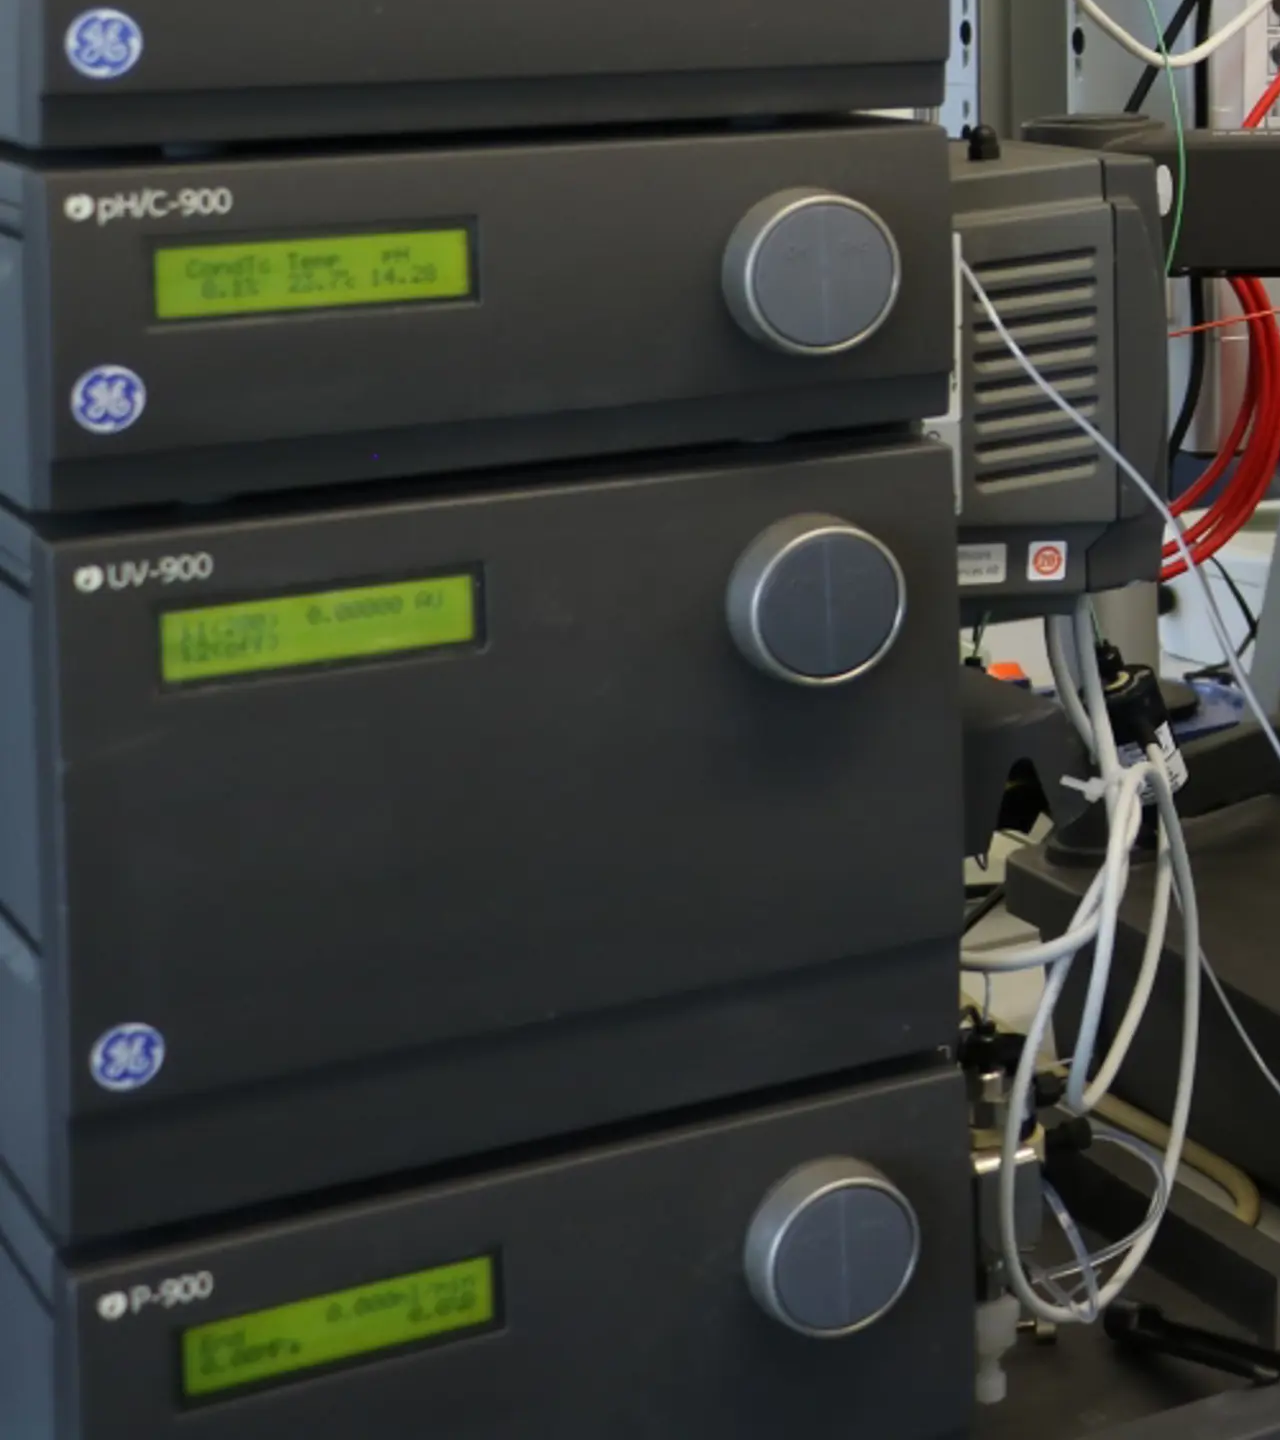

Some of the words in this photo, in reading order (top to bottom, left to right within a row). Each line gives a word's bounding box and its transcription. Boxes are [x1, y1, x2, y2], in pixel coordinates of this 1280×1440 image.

[98, 187, 233, 226] pH/C-900
[107, 553, 213, 591] UV-900
[131, 1270, 214, 1315] P-900
